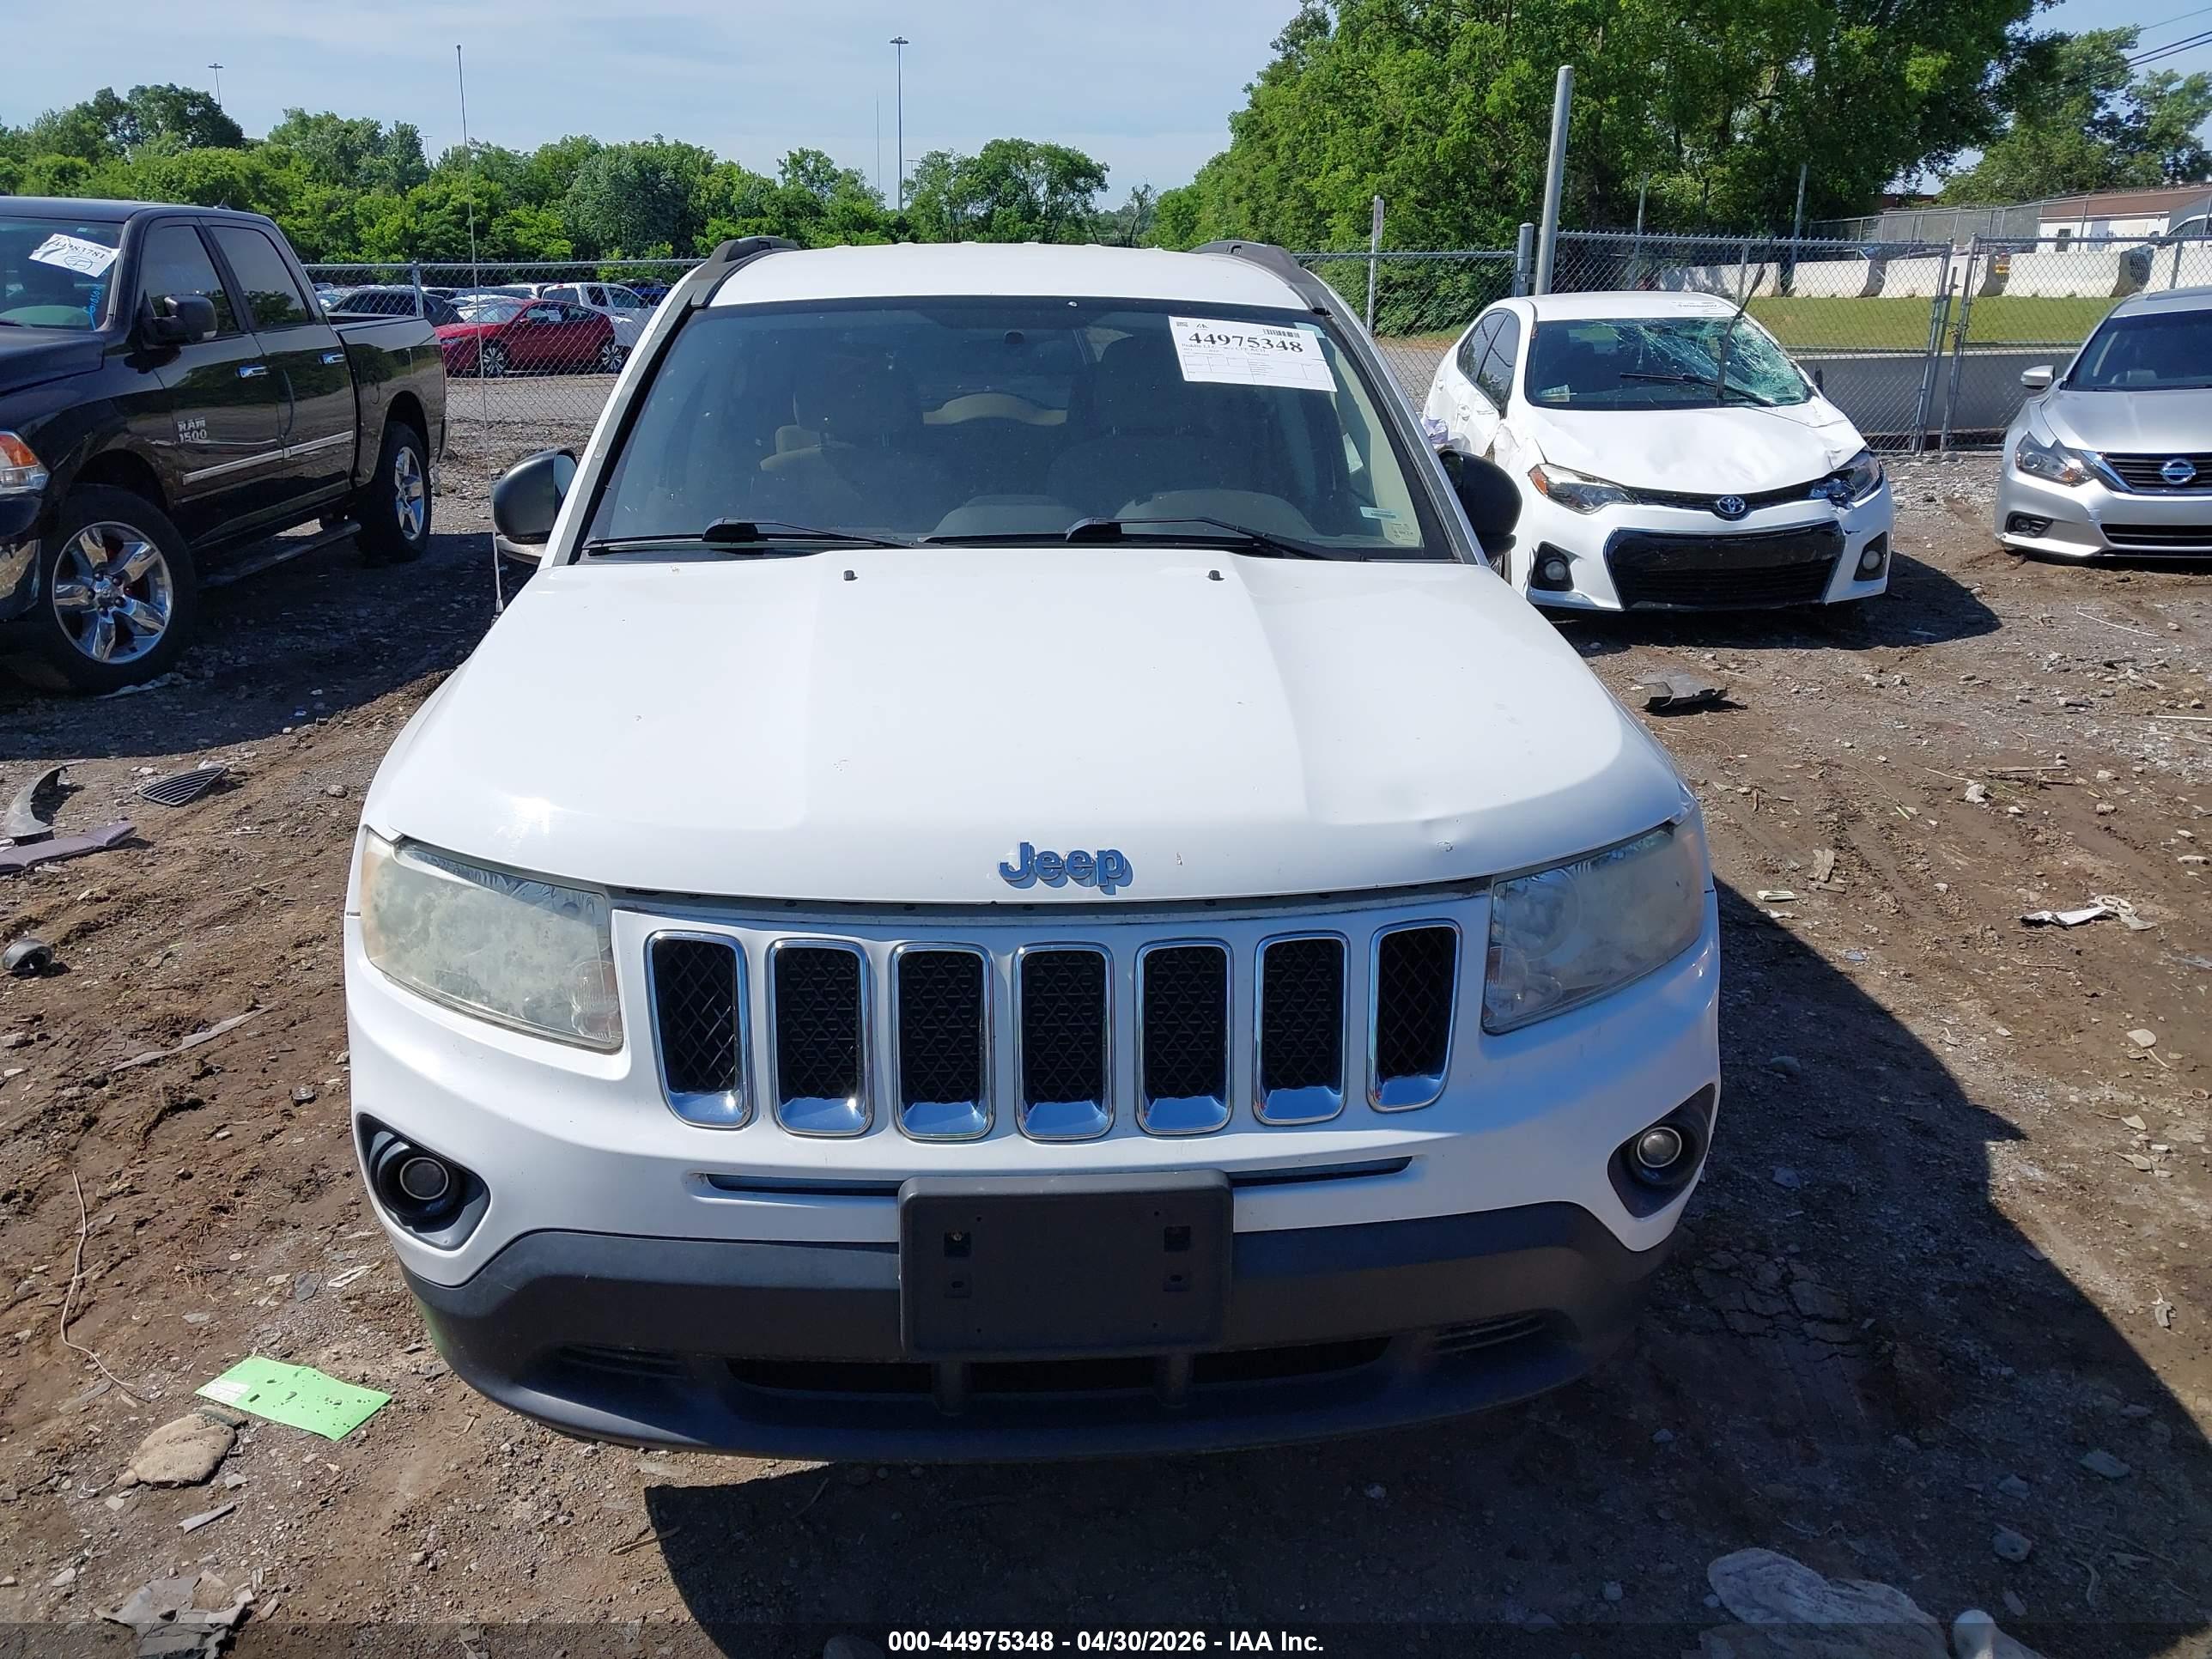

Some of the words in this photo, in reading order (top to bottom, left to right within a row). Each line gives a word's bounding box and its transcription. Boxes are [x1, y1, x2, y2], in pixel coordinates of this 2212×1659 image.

[1188, 332, 1304, 353] 44975348
[178, 418, 205, 432] RAM
[179, 429, 207, 443] 1500
[998, 841, 1133, 896] Jeep
